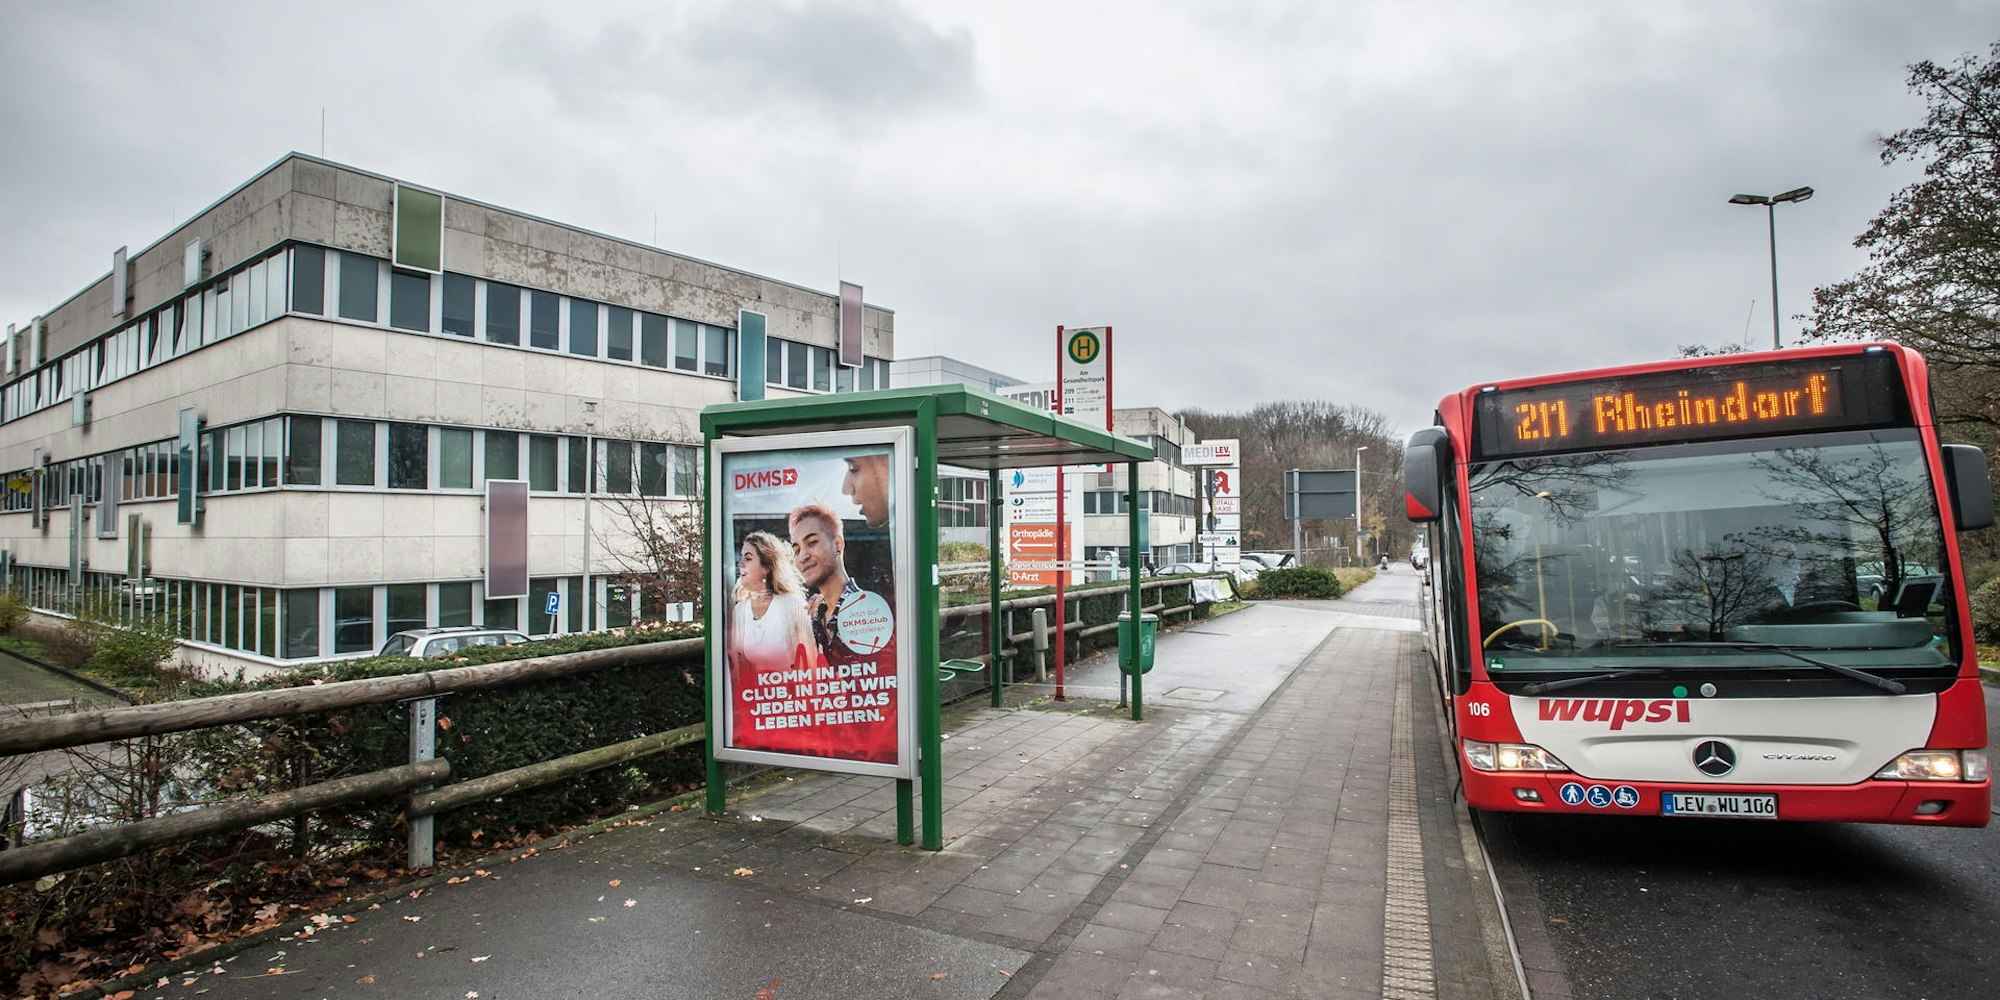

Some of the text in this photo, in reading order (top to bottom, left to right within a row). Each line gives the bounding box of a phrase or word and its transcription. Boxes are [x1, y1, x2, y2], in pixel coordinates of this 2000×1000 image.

[1077, 338, 1090, 357] H
[1063, 376, 1105, 384] Gesundheitspark
[1516, 375, 1828, 441] 211 Rheindorf
[1184, 446, 1231, 458] MEDI LEV.
[734, 469, 782, 490] DKMS
[1011, 528, 1054, 540] Orthopädie
[1012, 571, 1040, 581] D-Arzt
[549, 595, 557, 611] P
[842, 616, 889, 628] DKMS.club
[849, 611, 866, 619] Jetzt
[757, 661, 877, 686] KOMM IN DEN
[741, 675, 898, 702] CLUB, IN DEM WIR
[750, 691, 890, 717] JEDEN TAG DAS
[1467, 701, 1491, 717] 106
[1537, 688, 1691, 731] wupsi
[754, 708, 886, 731] LEBEN FEIERN.
[1762, 752, 1837, 761] CITARO
[1674, 796, 1705, 812] LEV
[1717, 797, 1739, 813] WU
[1742, 798, 1775, 814] 106
